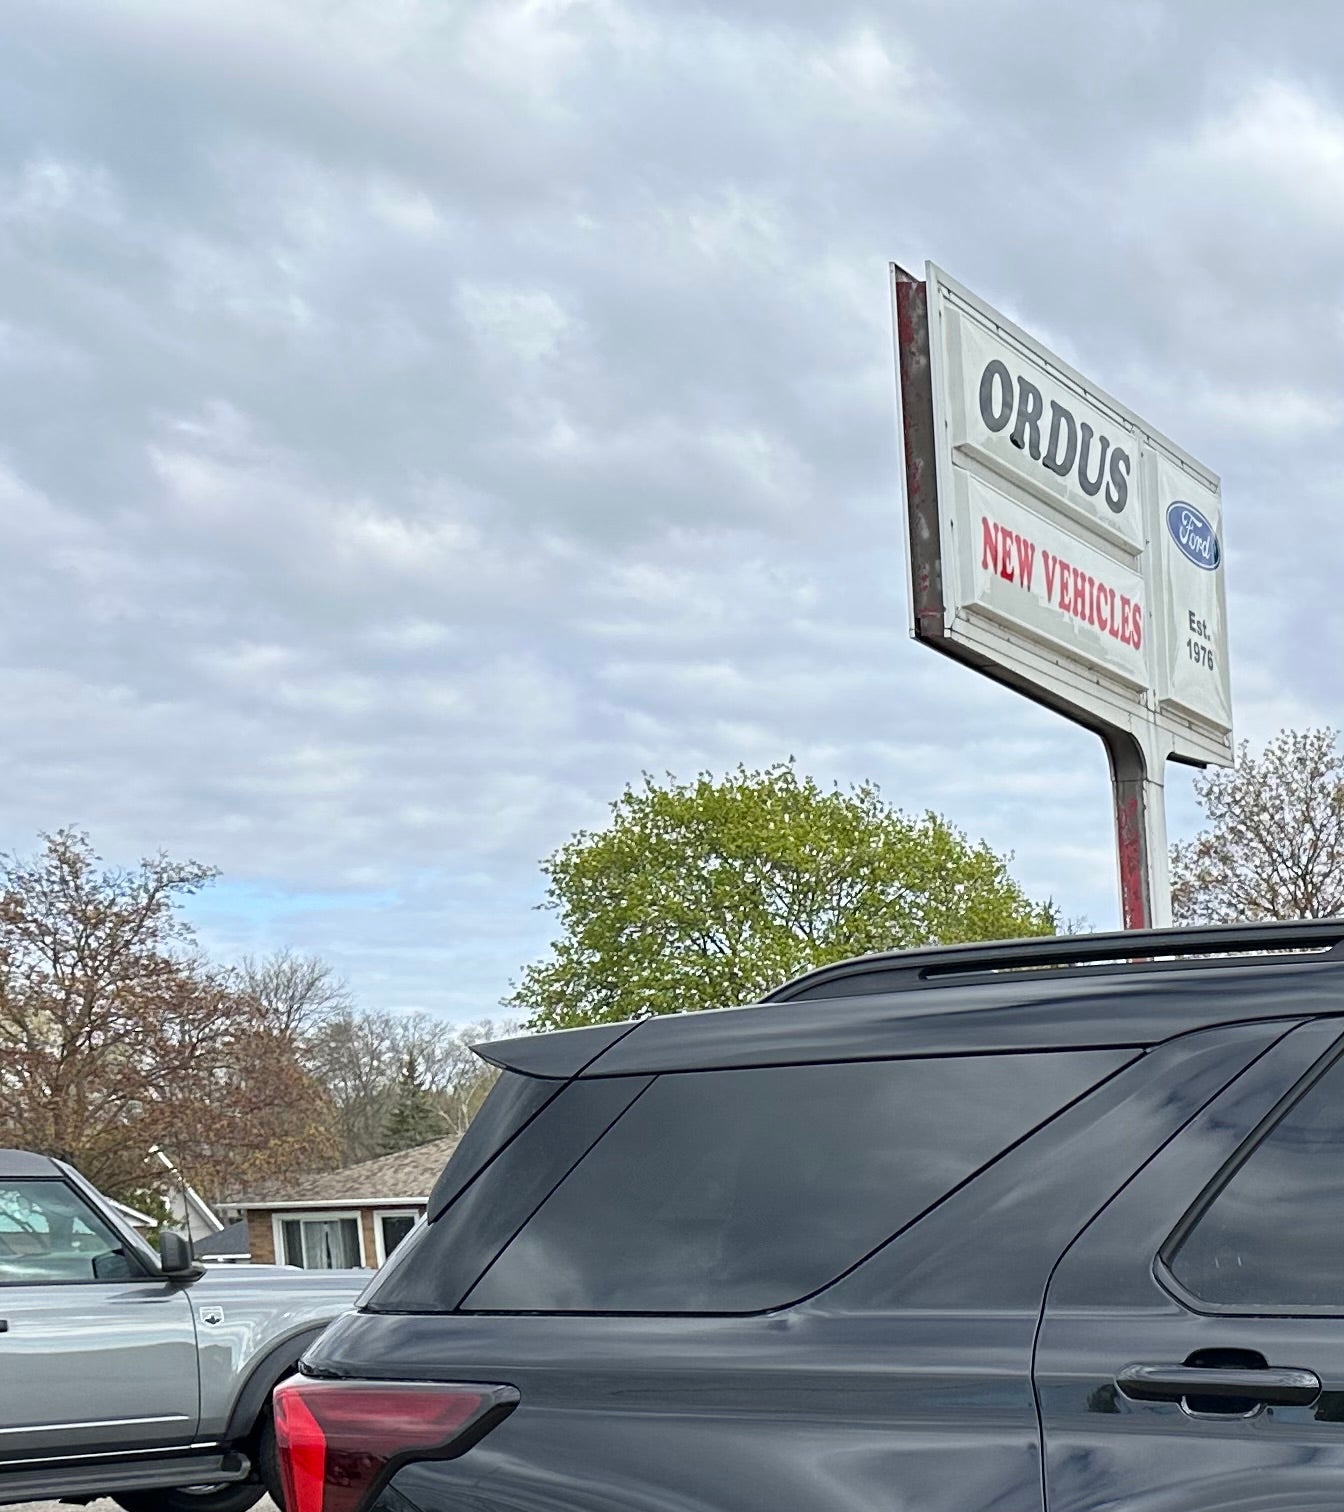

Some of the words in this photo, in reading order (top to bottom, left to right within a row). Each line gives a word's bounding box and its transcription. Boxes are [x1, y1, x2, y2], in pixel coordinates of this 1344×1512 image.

[979, 359, 1131, 513] ORDUS
[1179, 510, 1211, 559] Ford
[981, 516, 1036, 593] NEW
[1042, 550, 1142, 650] VEHICLES
[1188, 609, 1211, 642] Est.
[1186, 638, 1214, 671] 1976
